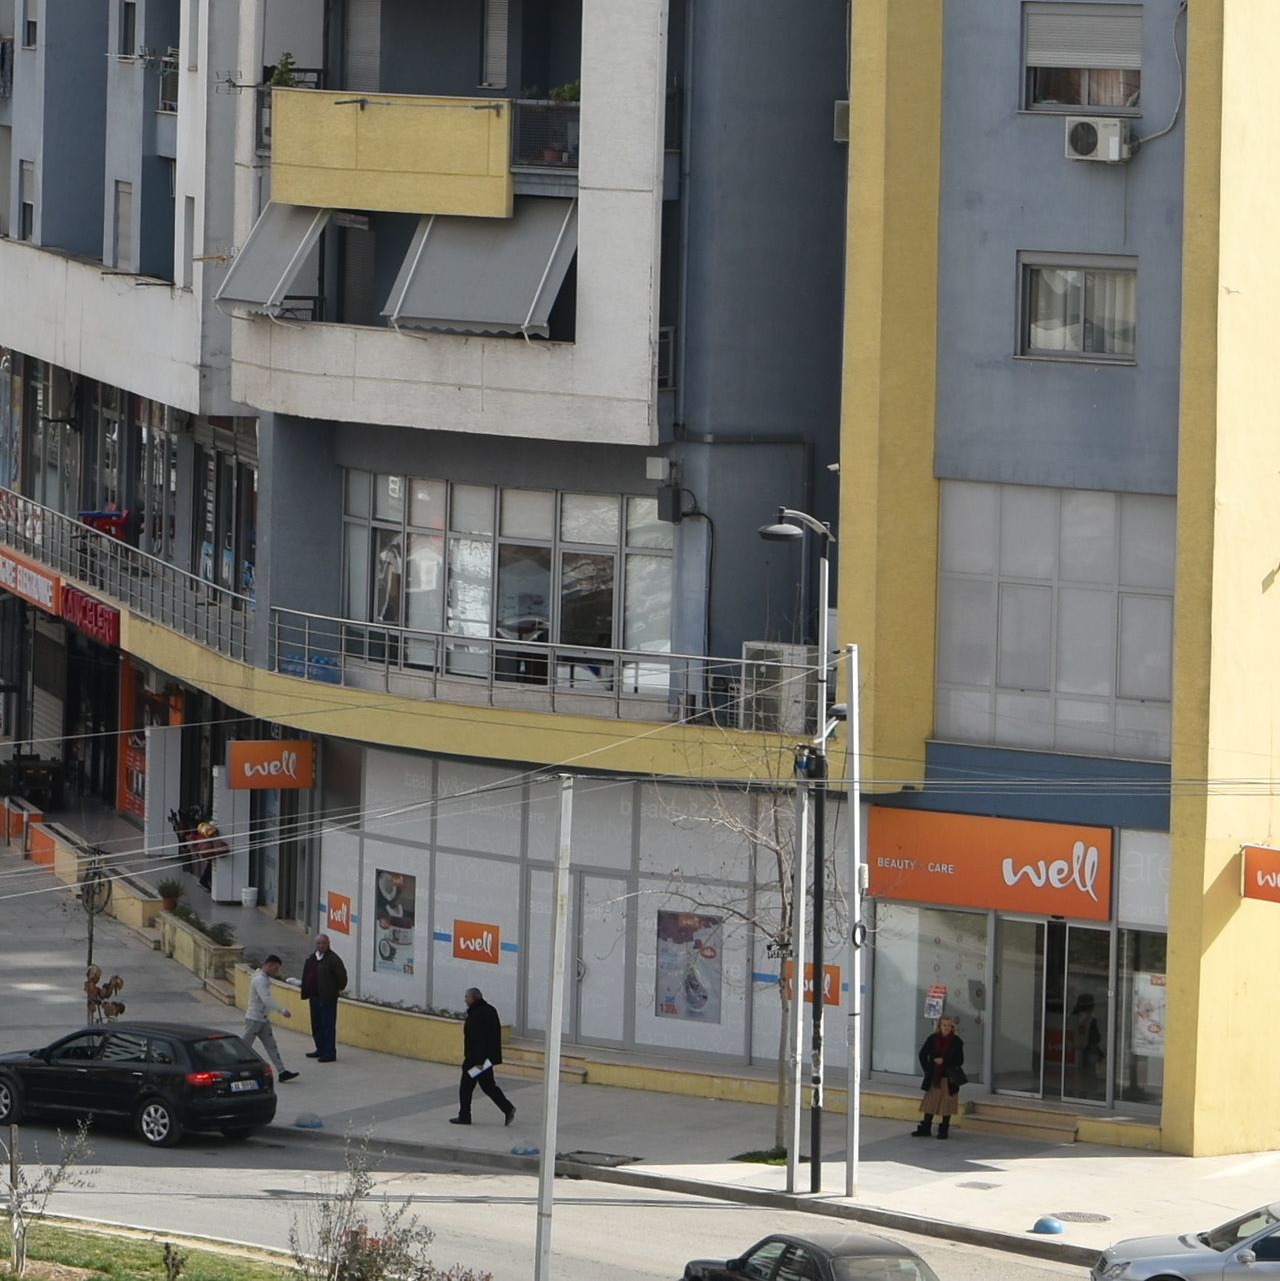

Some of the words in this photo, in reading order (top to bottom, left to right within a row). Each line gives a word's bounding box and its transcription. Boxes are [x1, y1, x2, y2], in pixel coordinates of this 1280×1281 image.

[244, 750, 297, 780] well
[877, 857, 915, 870] BEAUTY
[928, 862, 955, 875] CARE
[1002, 841, 1099, 903] well
[330, 903, 348, 928] well
[459, 931, 493, 958] well
